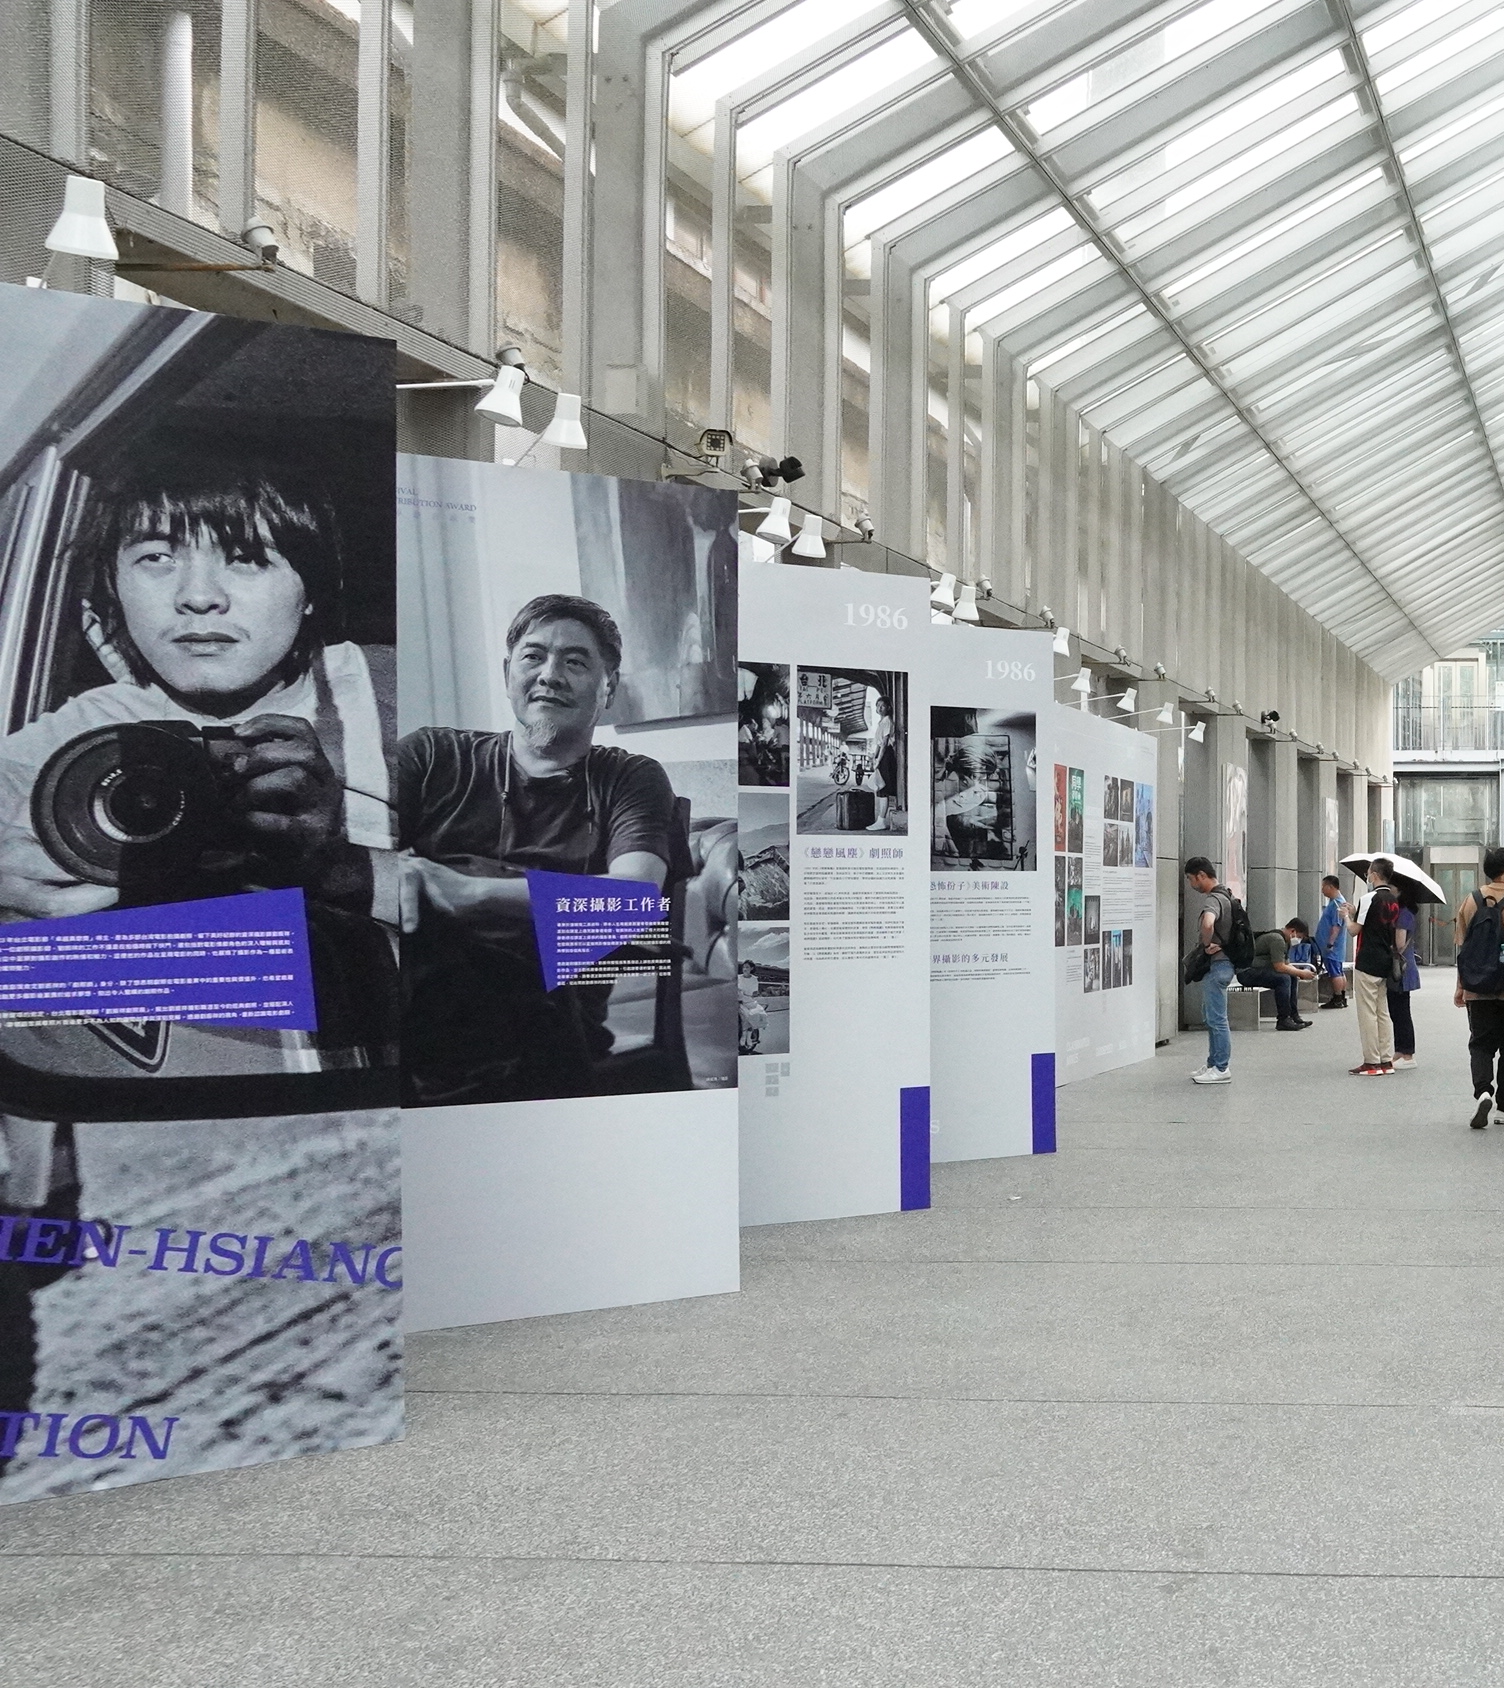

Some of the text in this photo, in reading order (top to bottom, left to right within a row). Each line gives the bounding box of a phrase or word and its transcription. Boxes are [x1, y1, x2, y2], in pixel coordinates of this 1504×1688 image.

[446, 502, 477, 511] AWARD
[843, 602, 909, 630] 1986
[985, 660, 1036, 682] 1986
[556, 896, 672, 913] 資深攝影工作者
